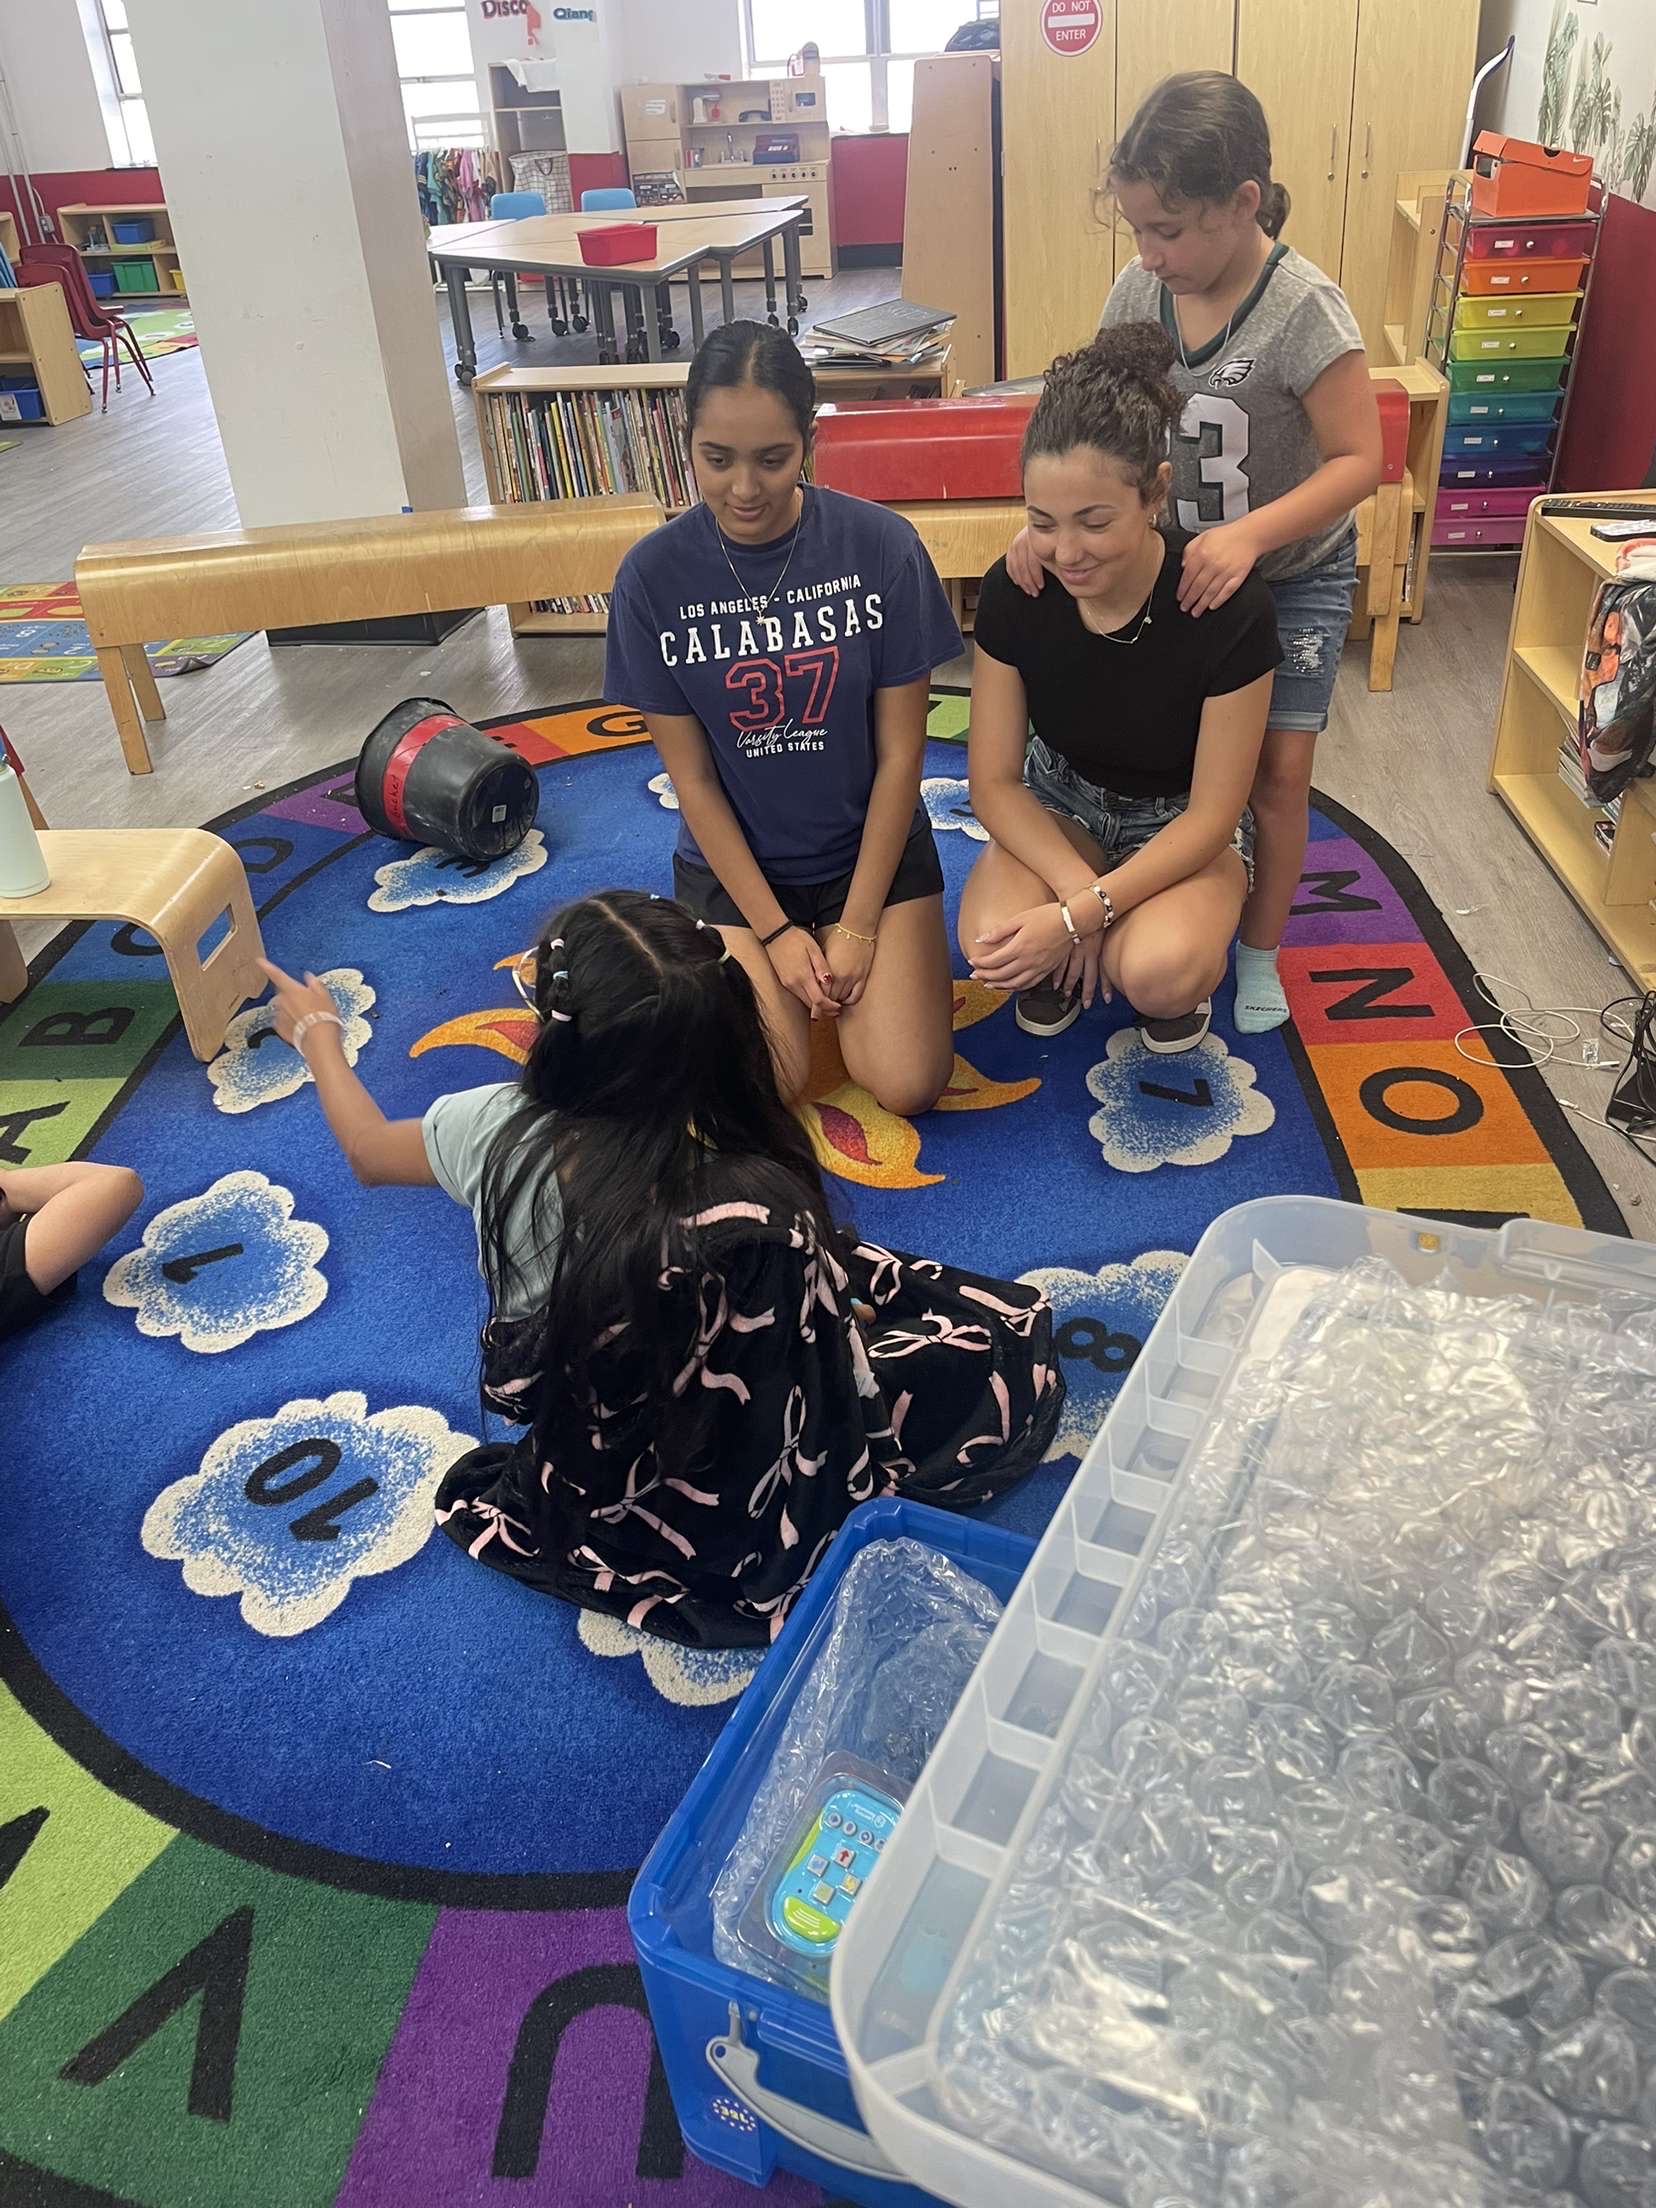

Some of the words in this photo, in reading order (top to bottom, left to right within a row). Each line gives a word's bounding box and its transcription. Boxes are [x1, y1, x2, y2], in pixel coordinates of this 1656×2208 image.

[1052, 2, 1066, 13] DO
[1071, 0, 1090, 12] NOT
[1056, 29, 1087, 41] ENTER
[679, 603, 705, 620] LOS
[711, 595, 768, 615] ANGELES
[787, 574, 862, 604] CALIFORNIA
[659, 593, 884, 667] CALABASAS
[724, 645, 840, 732] 37
[736, 725, 786, 749] Varsity
[783, 718, 828, 747] League
[746, 743, 783, 758] UNITED
[788, 740, 824, 752] STATES
[1289, 870, 1383, 916] M
[1308, 967, 1436, 1020] N
[18, 1006, 136, 1047] B
[1139, 1078, 1214, 1108] 7
[1359, 1066, 1485, 1136] O
[161, 1242, 244, 1285] 1
[1056, 1317, 1143, 1373] 8
[244, 1438, 379, 1542] 10
[59, 1904, 254, 2123] V
